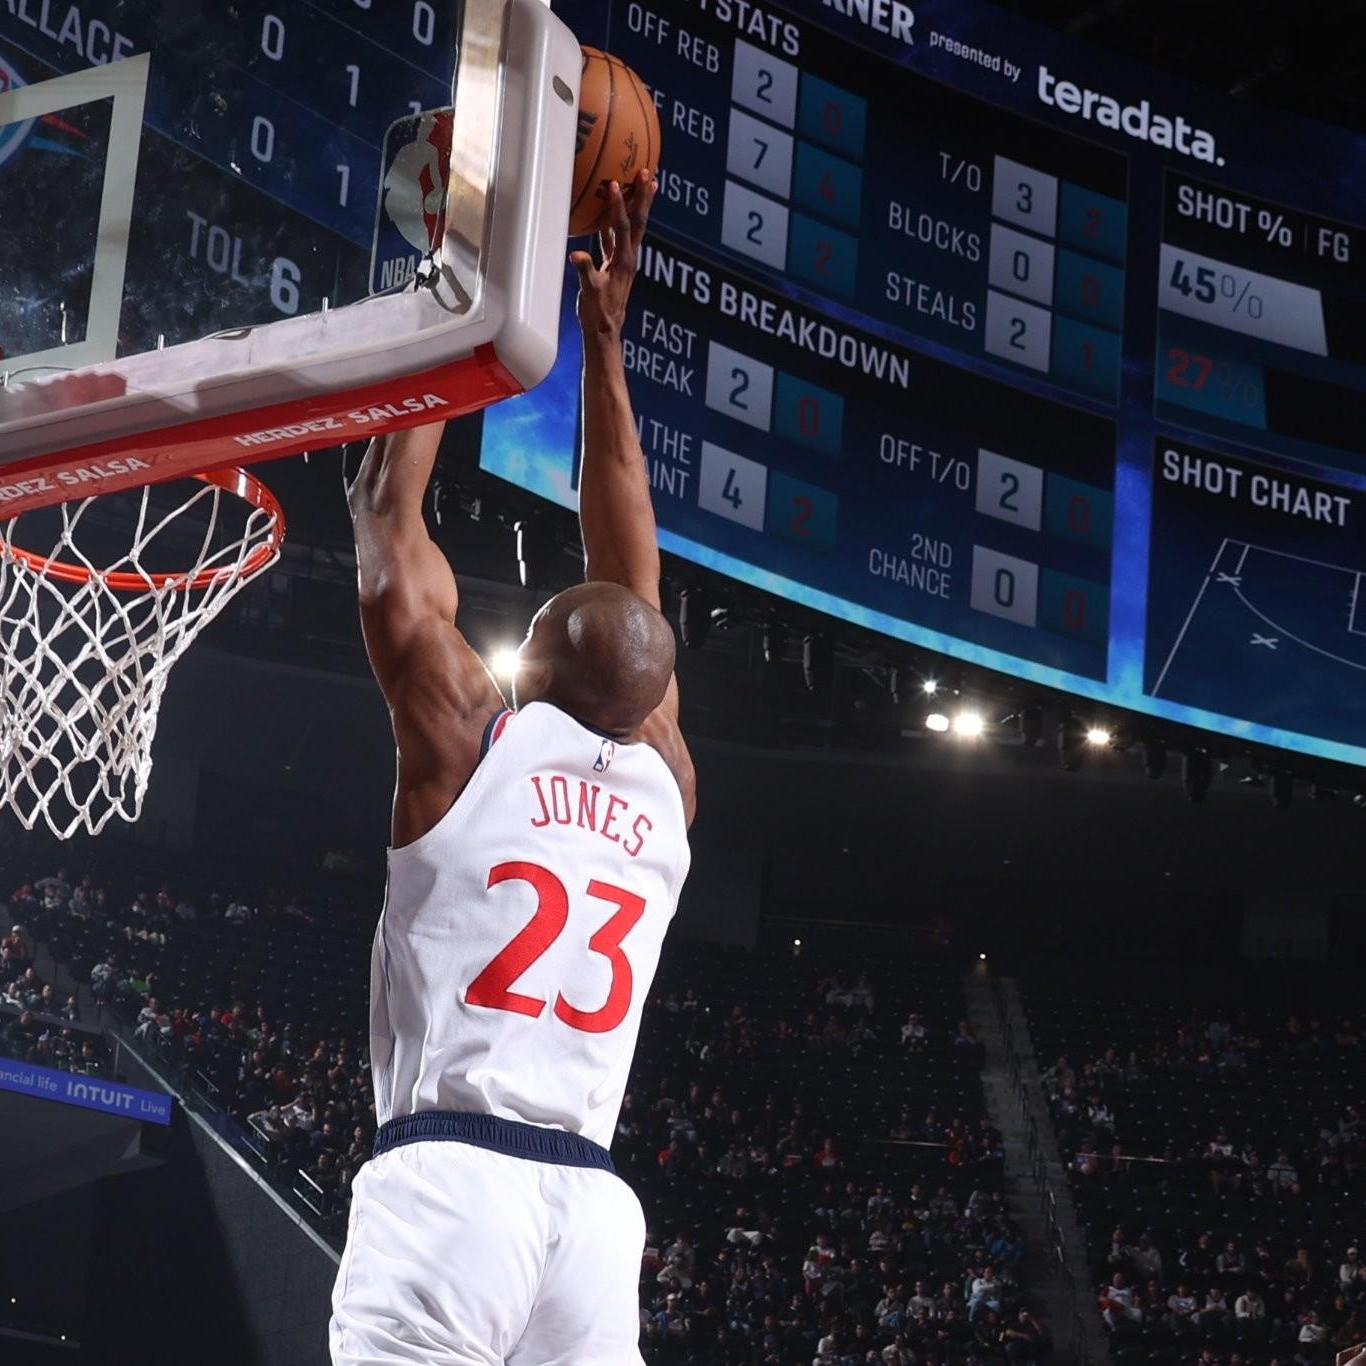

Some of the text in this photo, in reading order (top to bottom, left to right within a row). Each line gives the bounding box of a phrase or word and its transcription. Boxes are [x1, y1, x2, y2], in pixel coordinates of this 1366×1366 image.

[627, 4, 669, 46] OFF
[676, 34, 721, 74] REB
[756, 70, 774, 103] 2
[715, 0, 801, 56] STATS
[929, 29, 1001, 73] presented
[1003, 58, 1022, 82] by
[261, 15, 359, 106] 0 1
[251, 115, 350, 207] 0 1
[672, 103, 770, 170] REB 7
[940, 152, 982, 193] T/O
[1017, 182, 1033, 215] 3
[747, 211, 764, 246] 2
[888, 202, 982, 262] BLOCKS
[1013, 250, 1030, 283] 0
[1178, 185, 1350, 263] SHOT % FG
[270, 256, 301, 314] 6
[886, 272, 976, 332] STEALS
[1010, 317, 1028, 350] 2
[1168, 259, 1264, 320] 45%
[641, 310, 697, 359] FAST
[720, 281, 910, 389] BREAKDOWN
[622, 340, 693, 397] BREAK
[728, 368, 750, 410] 2
[234, 391, 449, 448] HERDEZ SALSA
[649, 419, 692, 466] THE
[58, 456, 152, 488] SALSA
[721, 466, 743, 510] 4
[880, 434, 922, 471] OFF
[928, 451, 971, 492] T/O
[999, 472, 1019, 512] 2
[1163, 449, 1351, 528] SHOT CHART
[869, 548, 951, 600] CHANCE
[994, 569, 1015, 608] 0
[910, 533, 952, 569] 2ND
[530, 775, 653, 857] JONES
[464, 860, 647, 1034] 23
[37, 1073, 58, 1092] life
[66, 1080, 135, 1110] INTUIT
[140, 1099, 167, 1116] Live
